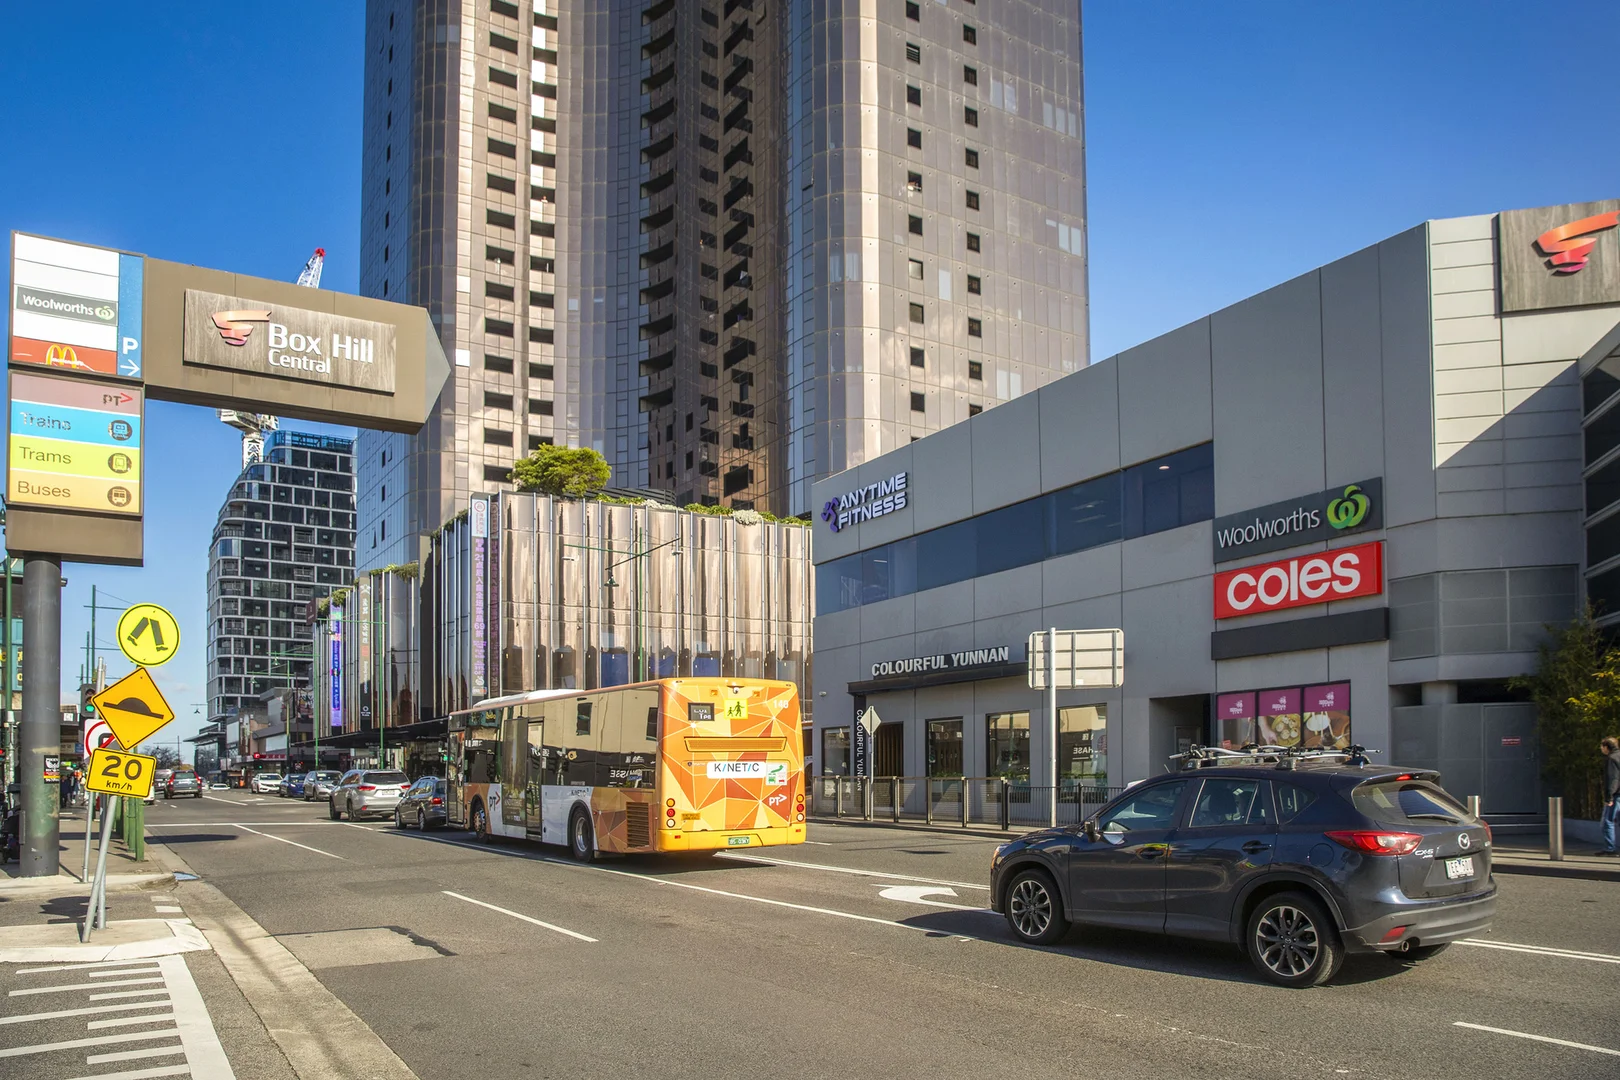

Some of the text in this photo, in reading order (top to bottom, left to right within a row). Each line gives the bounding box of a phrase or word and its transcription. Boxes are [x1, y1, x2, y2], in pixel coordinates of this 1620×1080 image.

[23, 294, 94, 316] Woolworths
[122, 337, 139, 354] P
[268, 323, 374, 364] Box Hill
[268, 349, 331, 374] Central
[19, 411, 72, 431] Trains
[19, 446, 72, 465] Trams
[17, 480, 71, 498] Buses
[839, 472, 908, 511] ANYTIME
[838, 491, 908, 530] FITNESS
[1217, 507, 1321, 549] Woolworths
[1227, 552, 1361, 611] coles
[871, 646, 1009, 677] COLOURFUL YUNNAN
[101, 755, 142, 780] 20
[106, 779, 133, 791] km/h
